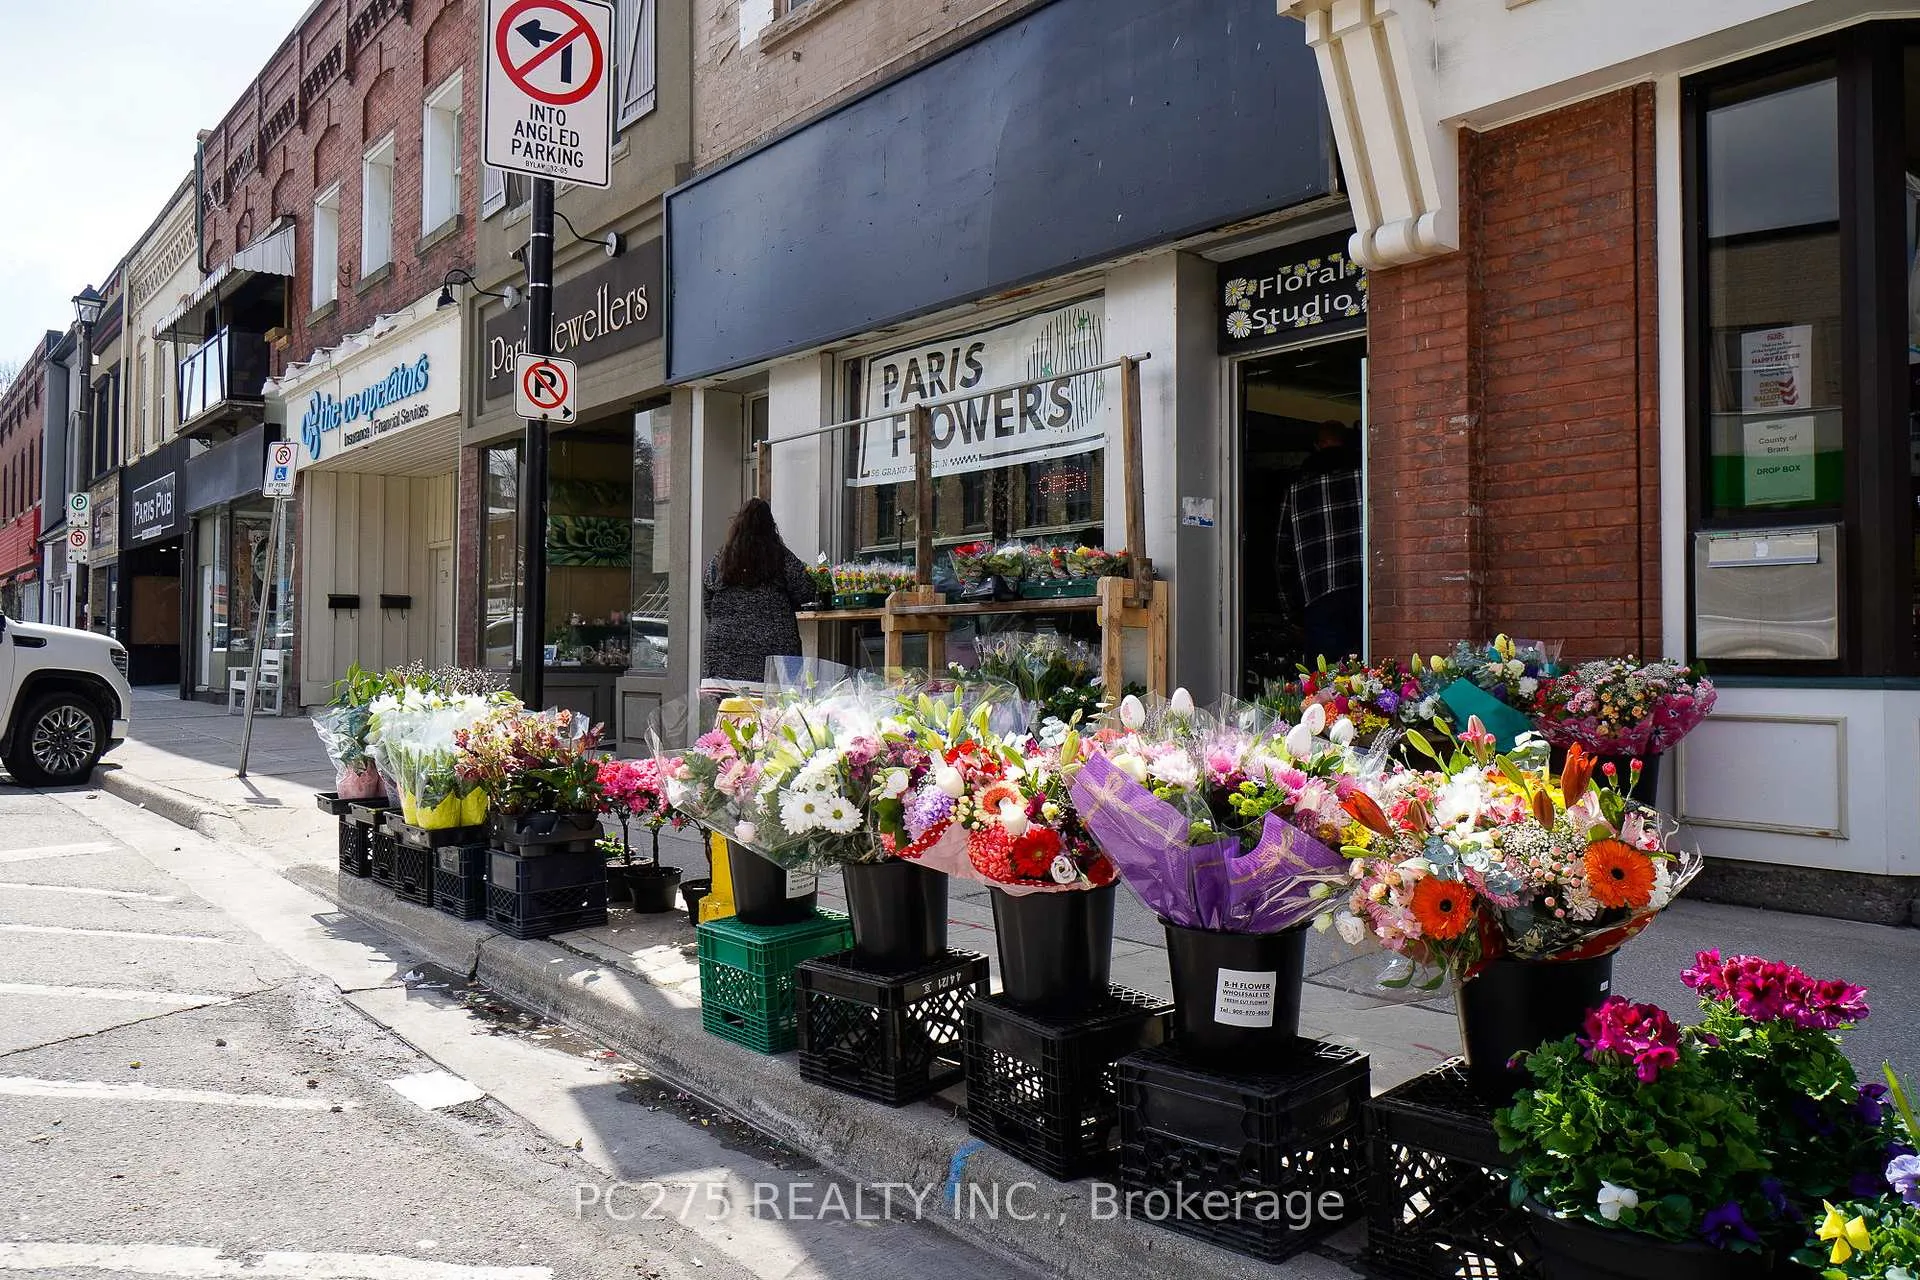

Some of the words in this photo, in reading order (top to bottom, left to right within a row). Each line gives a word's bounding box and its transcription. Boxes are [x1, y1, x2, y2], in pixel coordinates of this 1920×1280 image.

[529, 103, 566, 126] INTO
[514, 119, 580, 148] ANGLED
[511, 138, 584, 169] PARKING
[1259, 257, 1344, 299] Floral
[1251, 293, 1353, 330] Studio
[489, 325, 528, 380] Pari
[882, 341, 986, 408] PARIS
[320, 394, 341, 432] the
[344, 426, 370, 447] Insurance
[374, 411, 400, 435] Financial
[400, 404, 429, 425] Services
[891, 378, 1073, 458] FLOWERS
[1758, 436, 1787, 445] County
[1767, 446, 1789, 454] Brant
[882, 464, 907, 477] GRAND
[1038, 471, 1088, 495] OPEN
[1756, 467, 1781, 475] DROP
[1782, 464, 1801, 473] BOX
[134, 499, 154, 526] PARIS
[156, 492, 172, 519] PUB
[1222, 989, 1259, 998] WHOLESALE
[1239, 982, 1271, 990] FLOWER
